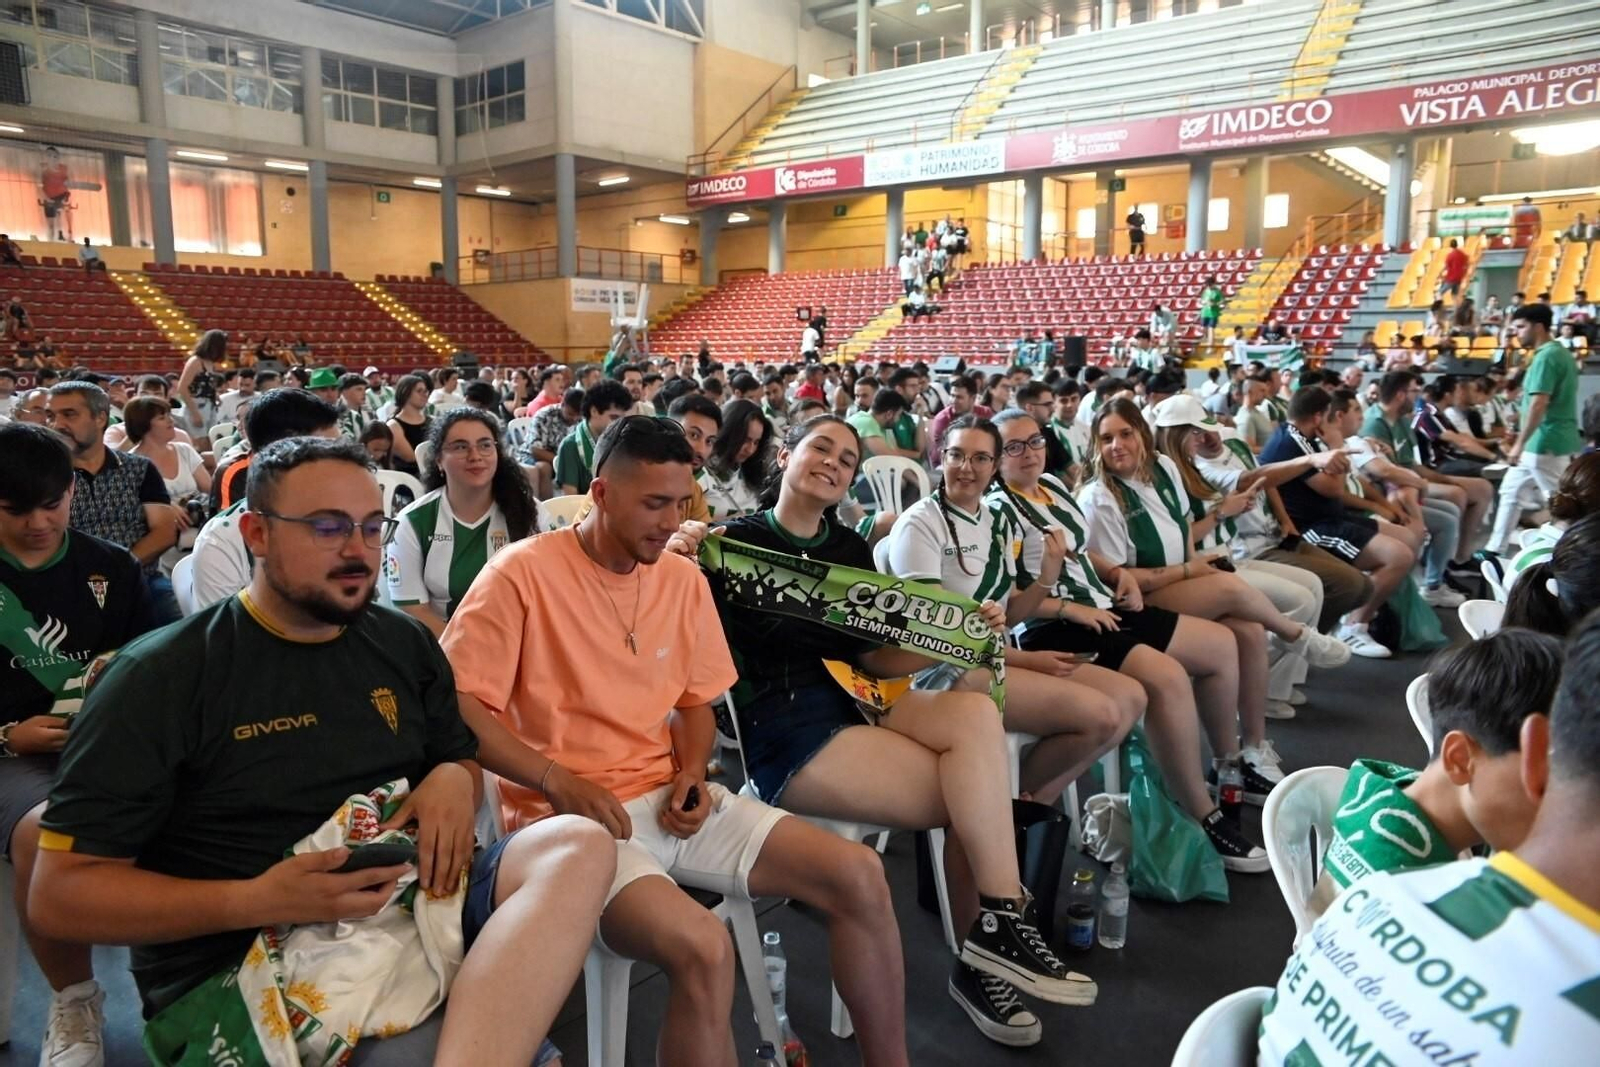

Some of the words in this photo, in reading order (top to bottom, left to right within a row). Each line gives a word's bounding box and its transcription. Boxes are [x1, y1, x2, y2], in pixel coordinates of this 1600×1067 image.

[1414, 82, 1469, 98] PALACIO
[1470, 72, 1544, 90] MUNICIPAL
[1400, 94, 1486, 126] VISTA
[1496, 78, 1600, 116] ALEG
[1212, 100, 1333, 136] IMDECO
[920, 143, 989, 161] PATRIMONIO
[1210, 136, 1247, 147] Municipal
[920, 157, 1000, 176] HUMANIDAD
[700, 176, 747, 194] IMDECO
[944, 544, 979, 556] GIOVA
[845, 614, 912, 643] SIEMPRE
[912, 634, 976, 664] UNIDOS,
[10, 649, 91, 669] CajaSur
[233, 713, 318, 740] GIVOVA
[1354, 974, 1386, 1003] de
[1377, 999, 1412, 1031] un
